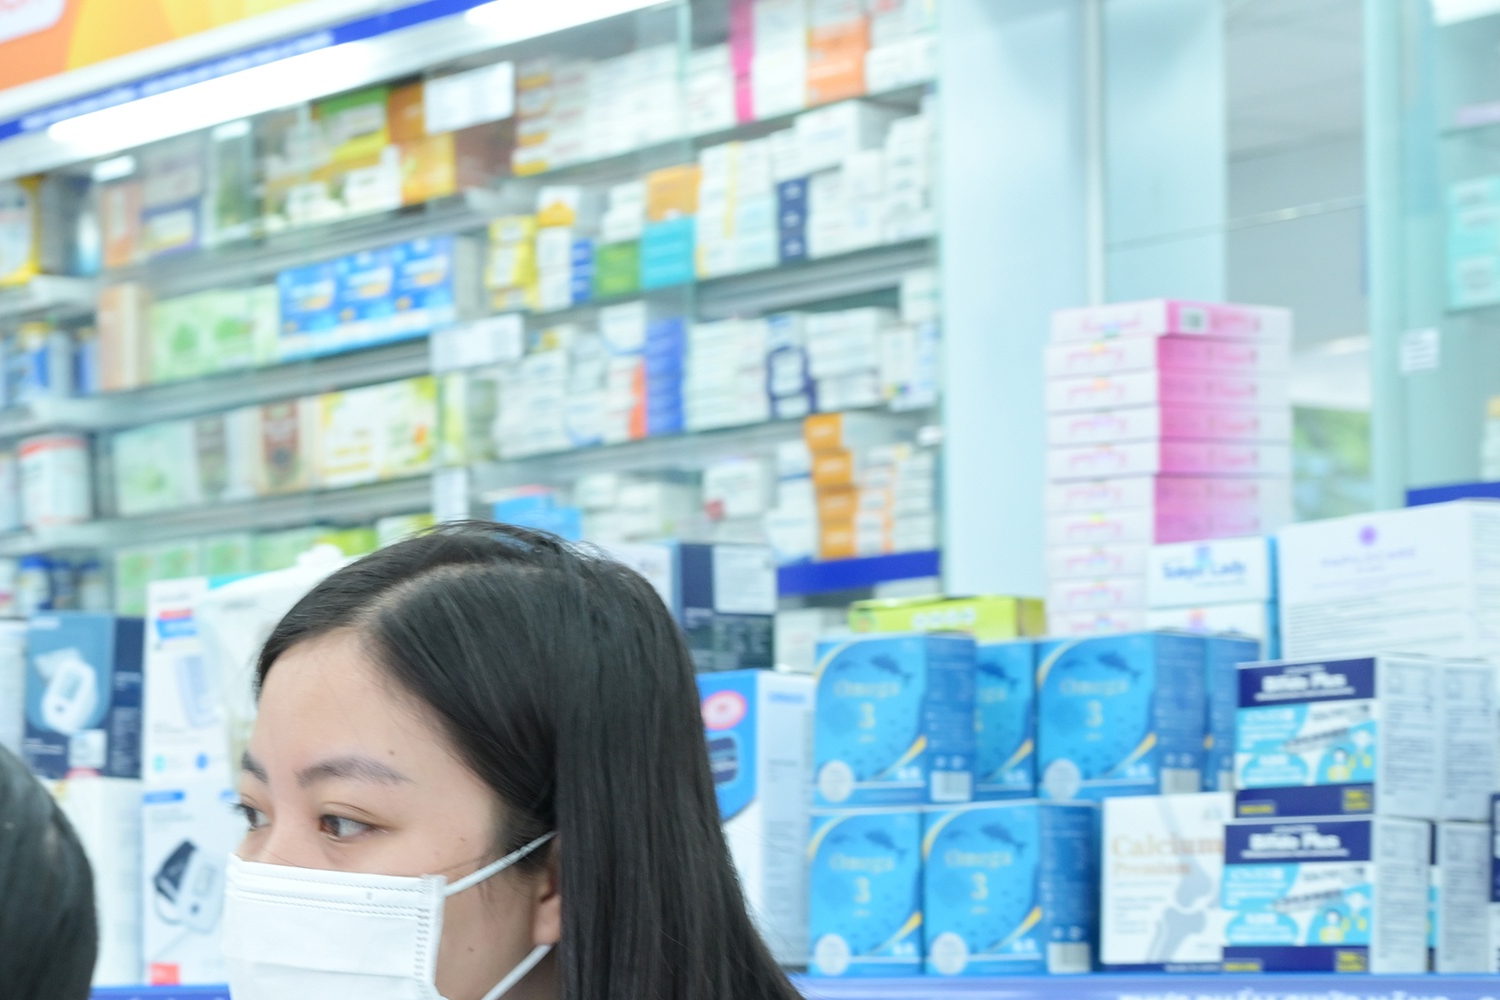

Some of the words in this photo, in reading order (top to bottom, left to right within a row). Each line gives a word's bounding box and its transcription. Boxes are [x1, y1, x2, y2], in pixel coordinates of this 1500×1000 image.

[859, 702, 875, 729] 3
[1085, 699, 1103, 727] 3
[854, 876, 871, 904] 3
[971, 872, 988, 900] 3
